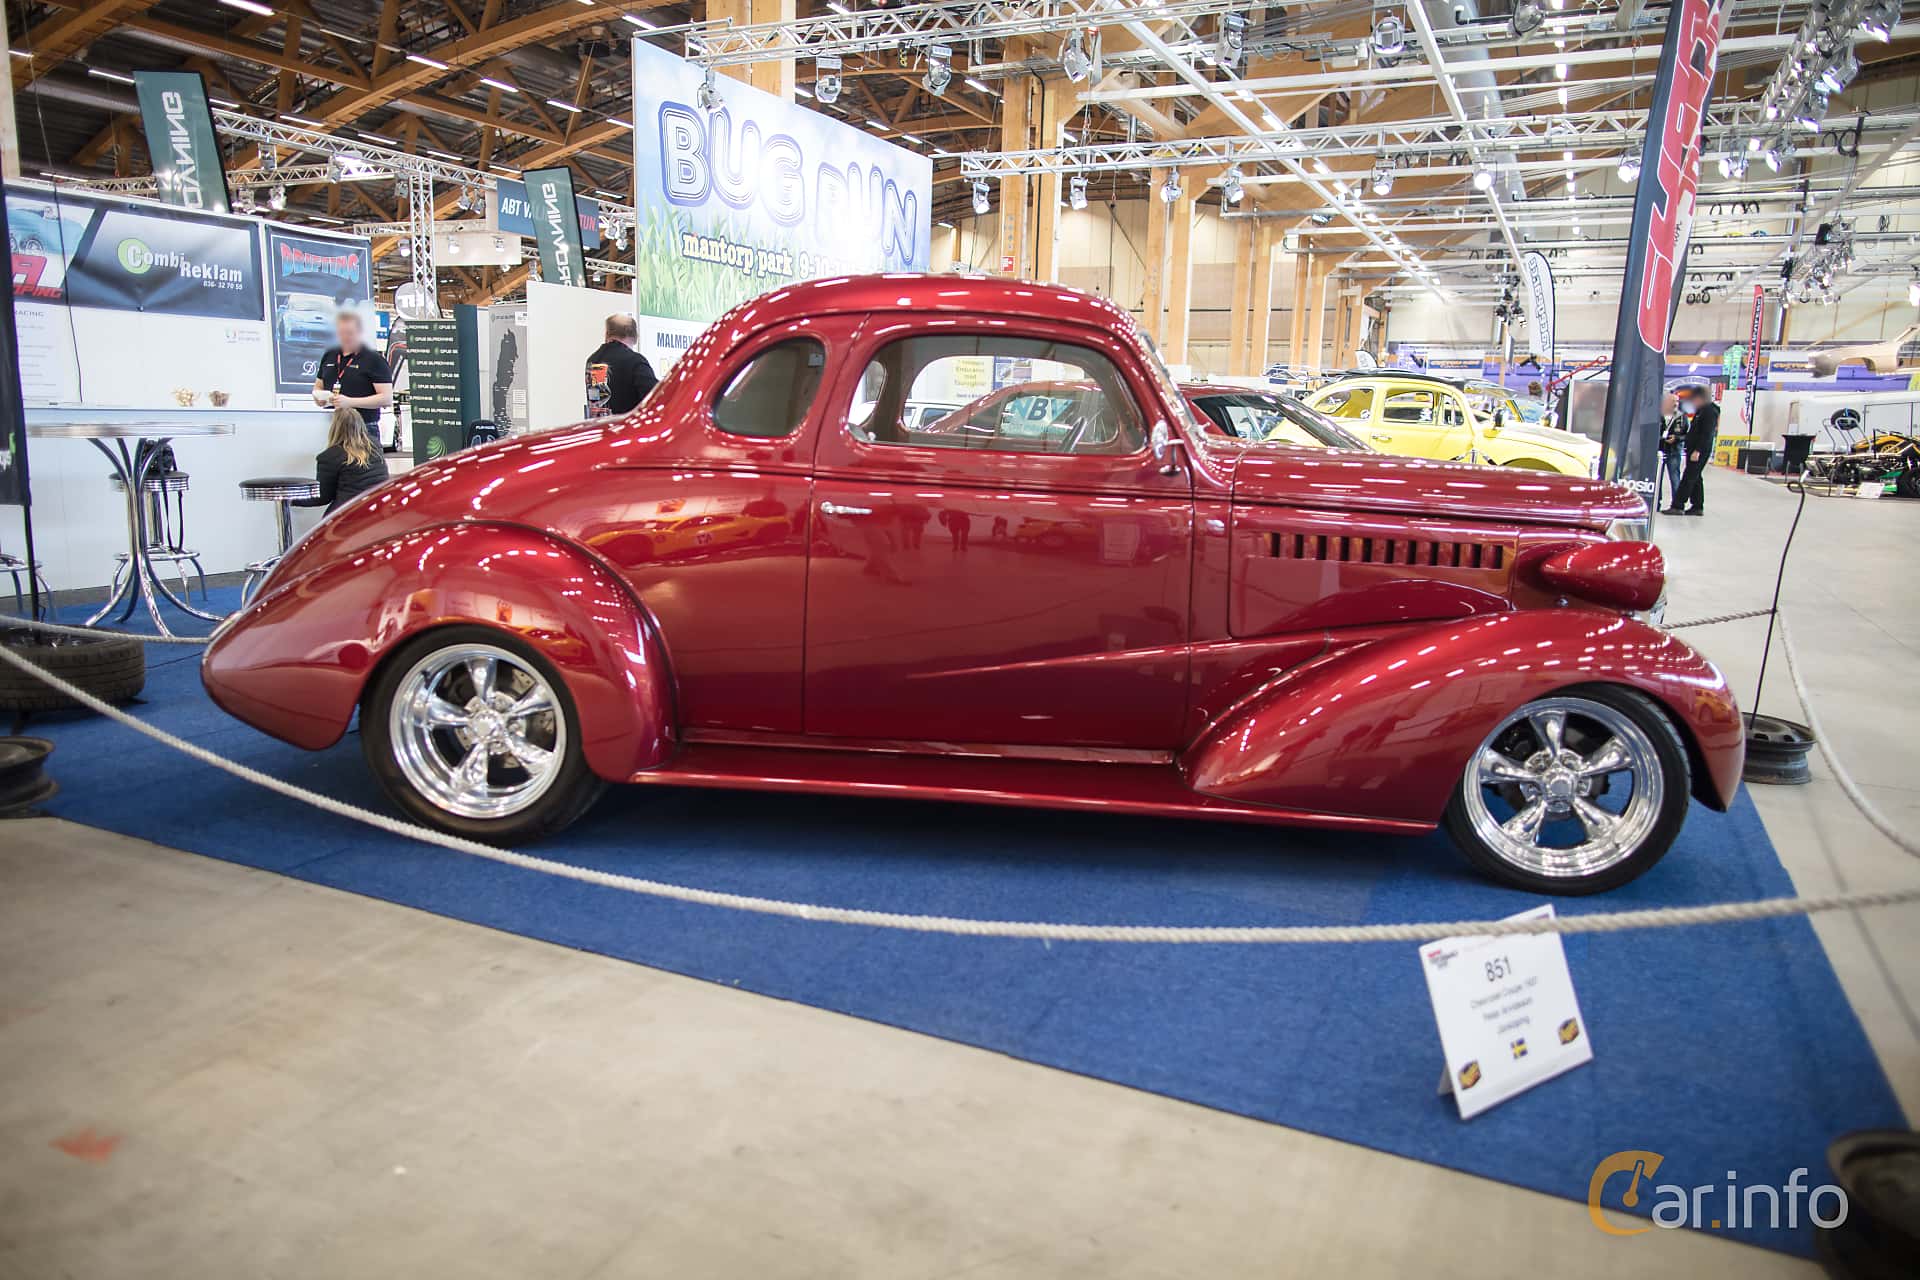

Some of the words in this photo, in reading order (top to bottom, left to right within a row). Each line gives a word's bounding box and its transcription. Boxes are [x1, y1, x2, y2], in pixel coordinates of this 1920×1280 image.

[658, 100, 806, 227] BUG
[815, 161, 917, 266] RUN
[500, 197, 522, 217] ABT
[127, 244, 185, 268] Combi
[279, 241, 360, 284] DRIFTING
[682, 232, 754, 276] mantorp
[756, 247, 793, 278] park
[179, 260, 243, 282] Reklam
[1484, 955, 1512, 983] 851
